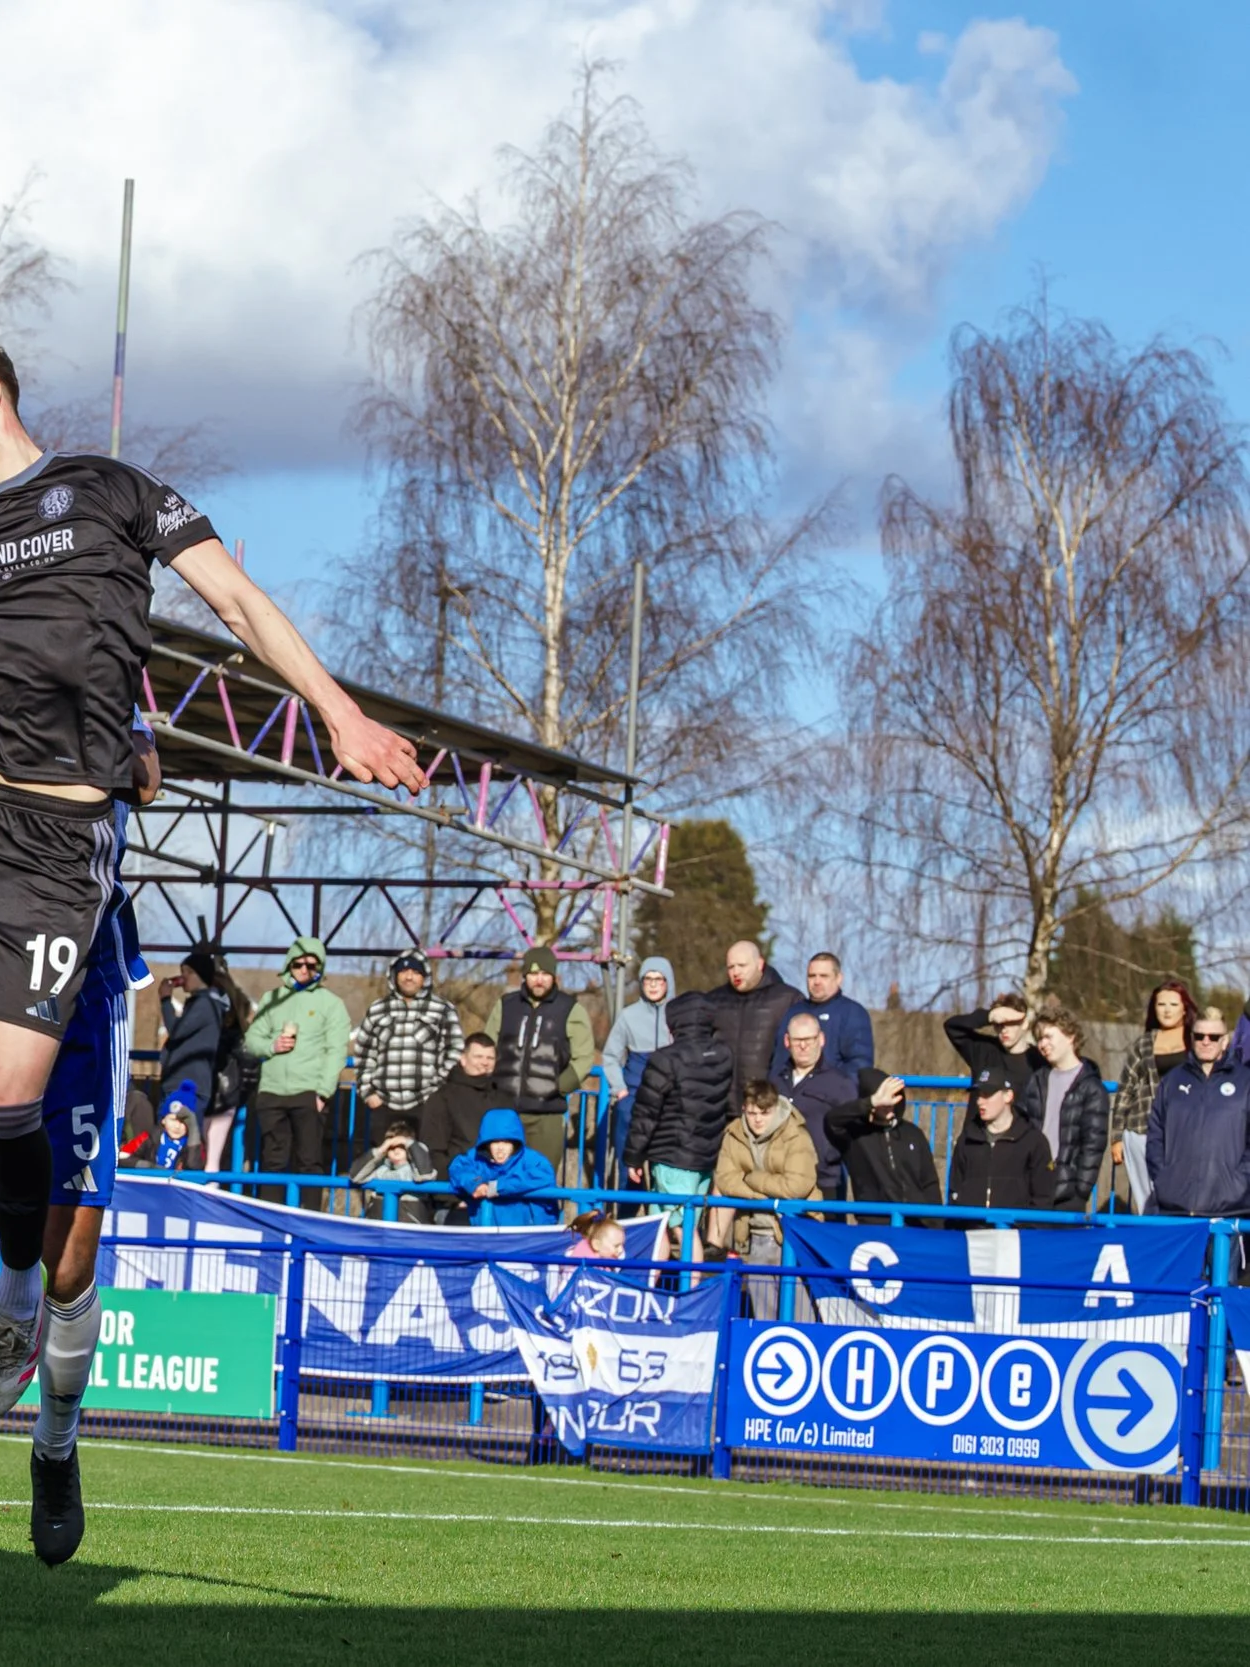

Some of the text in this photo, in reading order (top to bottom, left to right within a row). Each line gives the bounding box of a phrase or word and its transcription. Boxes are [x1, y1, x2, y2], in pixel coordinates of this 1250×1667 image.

[20, 528, 74, 559] COVER
[26, 933, 78, 995] 19
[71, 1104, 100, 1160] 5
[277, 1233, 568, 1354] NAS
[1084, 1243, 1134, 1308] A
[99, 1309, 135, 1346] OR
[117, 1352, 219, 1393] LEAGUE
[618, 1349, 668, 1383] 63
[744, 1418, 874, 1448] HPE (m/c) Limited
[952, 1433, 1040, 1459] 0161 303 0999
